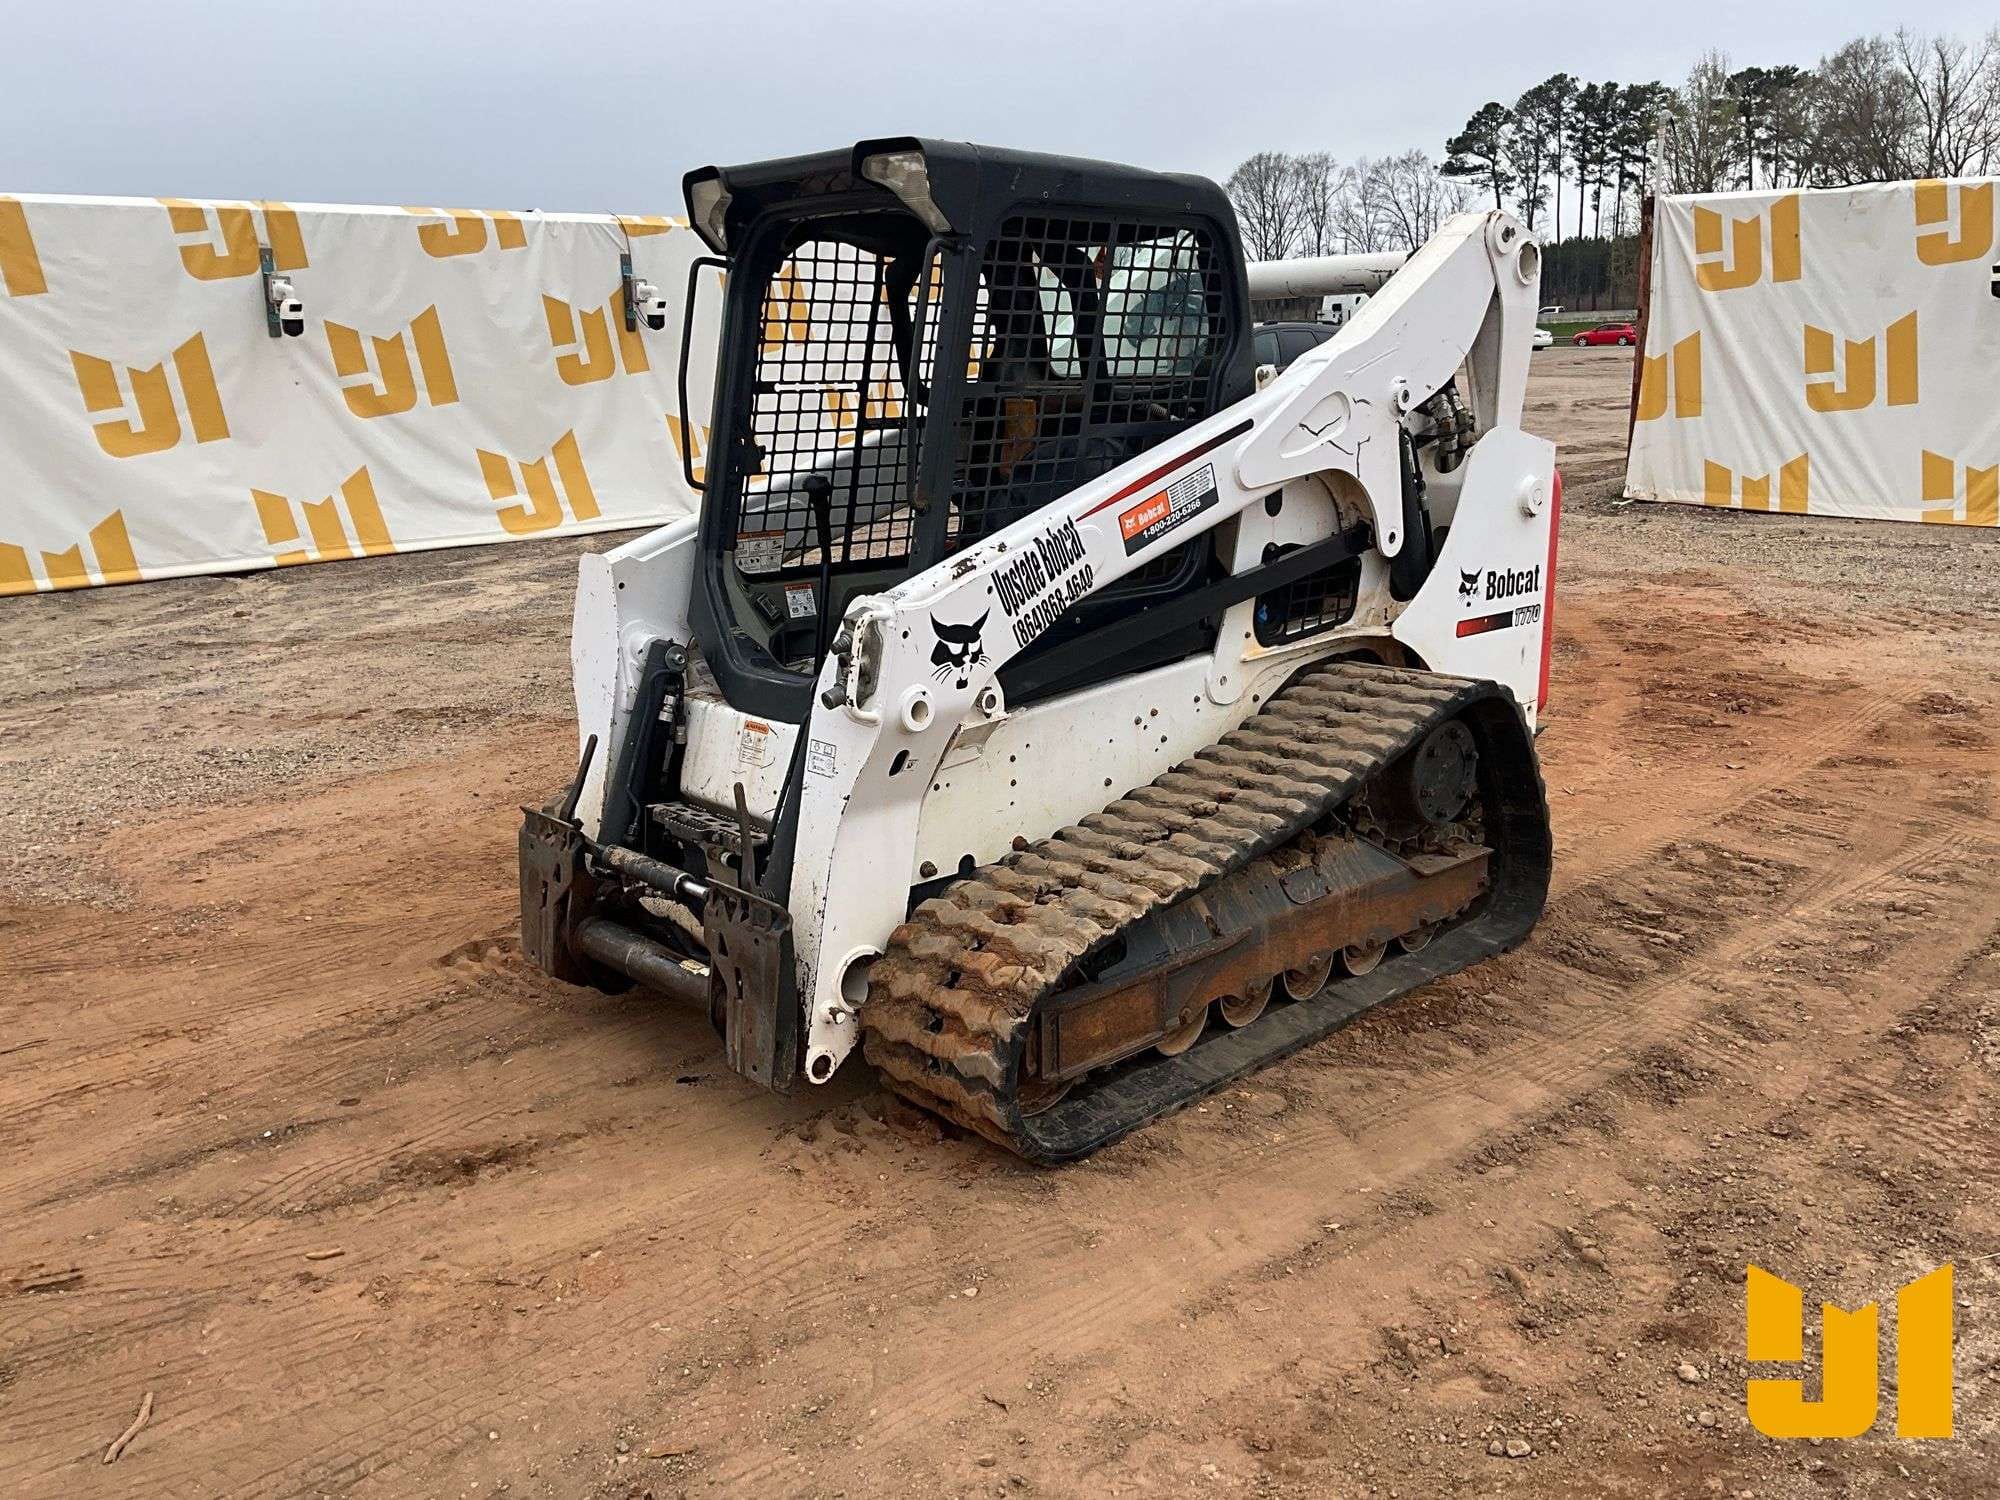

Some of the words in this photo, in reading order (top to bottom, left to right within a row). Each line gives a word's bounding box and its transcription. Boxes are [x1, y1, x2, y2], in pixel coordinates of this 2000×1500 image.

[1138, 502, 1165, 524] Bobcat
[1142, 499, 1201, 538] 1-800-220-6266
[991, 550, 1046, 617] Upstate
[1033, 514, 1086, 582] Bobcat
[1486, 564, 1540, 600] Bobcat
[1515, 603, 1541, 627] T770
